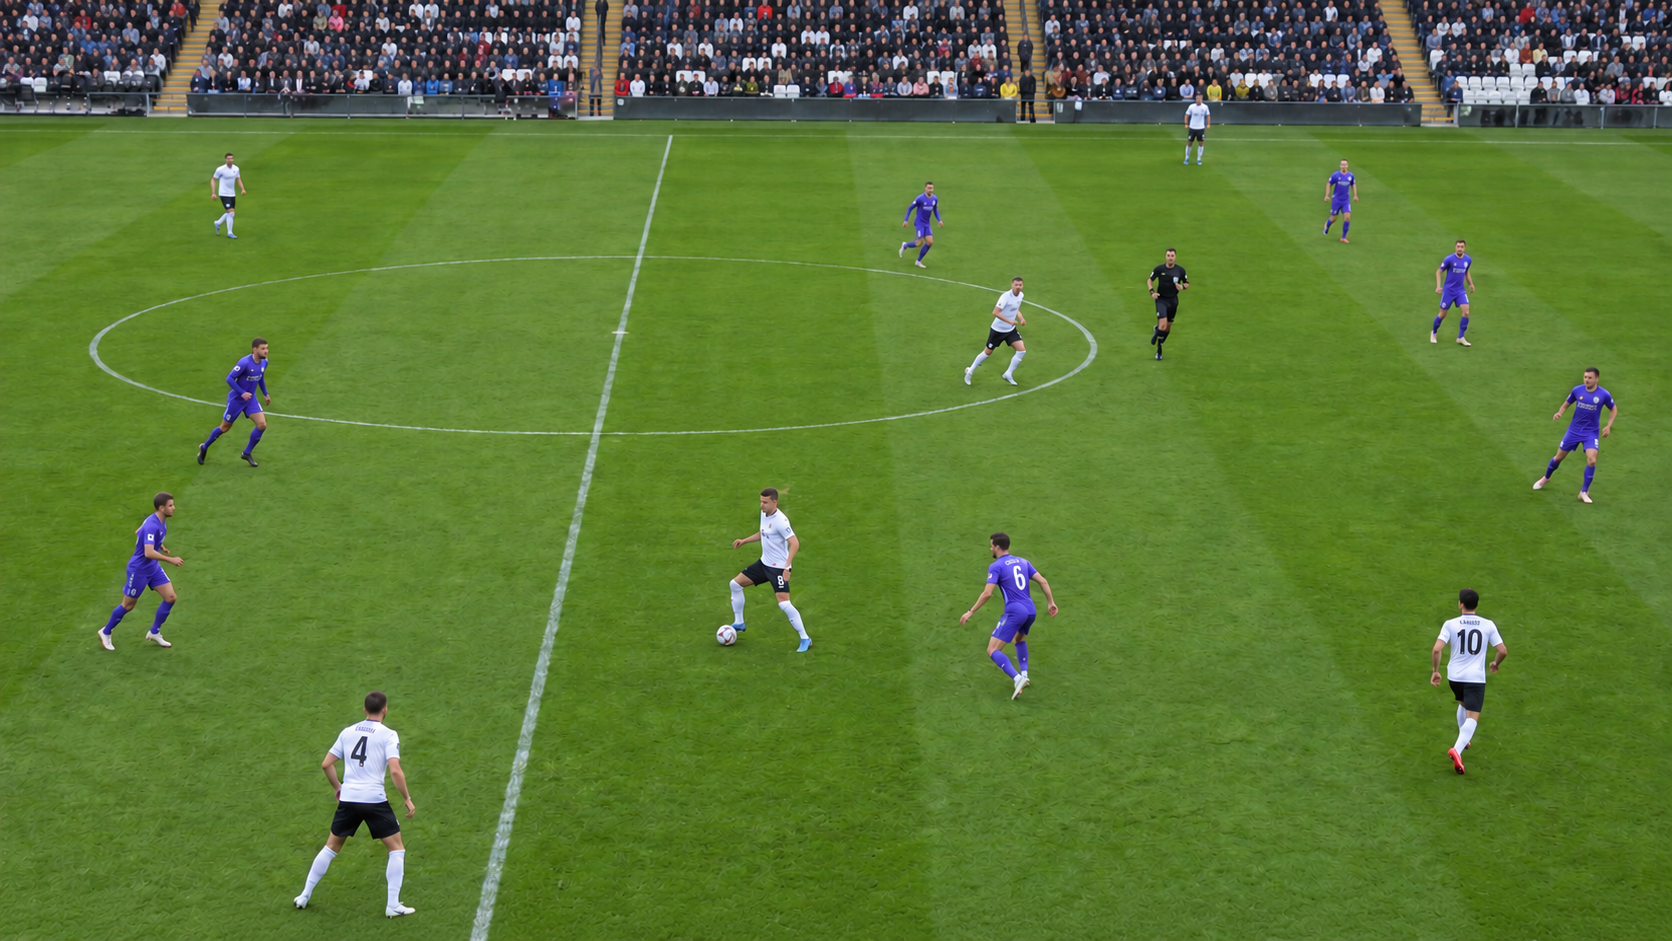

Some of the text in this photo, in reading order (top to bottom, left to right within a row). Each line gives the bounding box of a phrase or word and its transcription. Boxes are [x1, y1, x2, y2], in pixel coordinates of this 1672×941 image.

[777, 575, 785, 586] 8
[1013, 565, 1026, 590] 6
[1457, 628, 1483, 656] 10
[350, 735, 368, 768] 4
